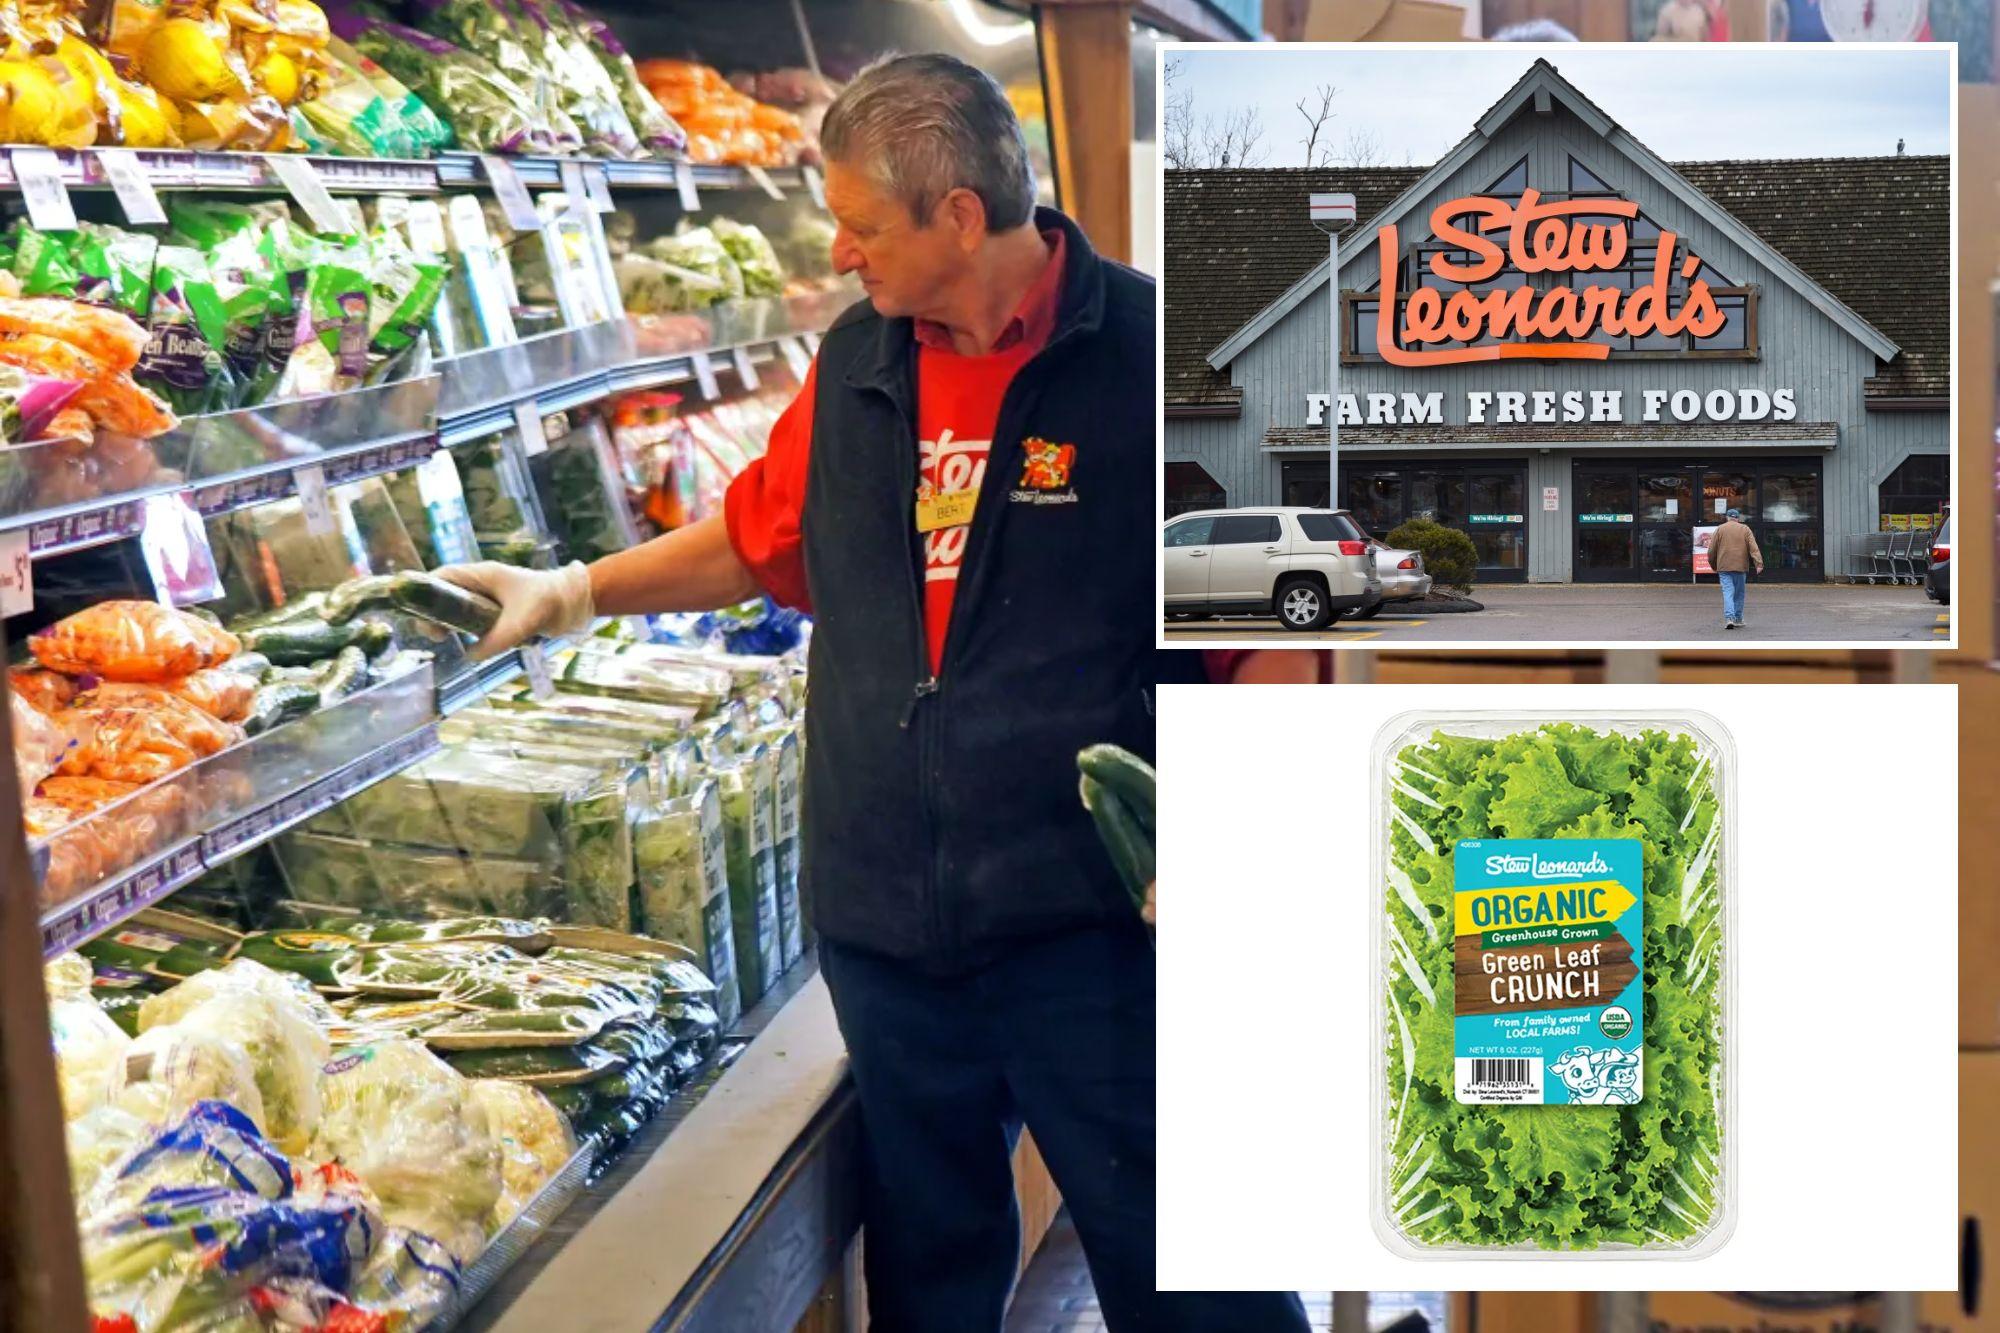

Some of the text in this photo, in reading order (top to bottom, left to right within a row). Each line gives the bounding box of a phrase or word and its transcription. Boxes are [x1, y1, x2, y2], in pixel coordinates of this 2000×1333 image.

[1429, 187, 1640, 283] Stew
[1376, 230, 1728, 368] Leonard's
[1305, 388, 1798, 425] FARM FRESH FOODS
[1485, 851, 1608, 878] Stew Leonard's
[1471, 888, 1608, 927] ORGANIC
[1491, 928, 1599, 944] Greenhouse Grown
[1481, 943, 1602, 974] Green Leaf
[1490, 970, 1600, 1005] CRUNCH
[1494, 1013, 1591, 1028] From family owned
[1506, 1025, 1581, 1039] LOCAL FARMS!
[1468, 1046, 1484, 1054] NET
[1520, 1046, 1544, 1055] (227g)
